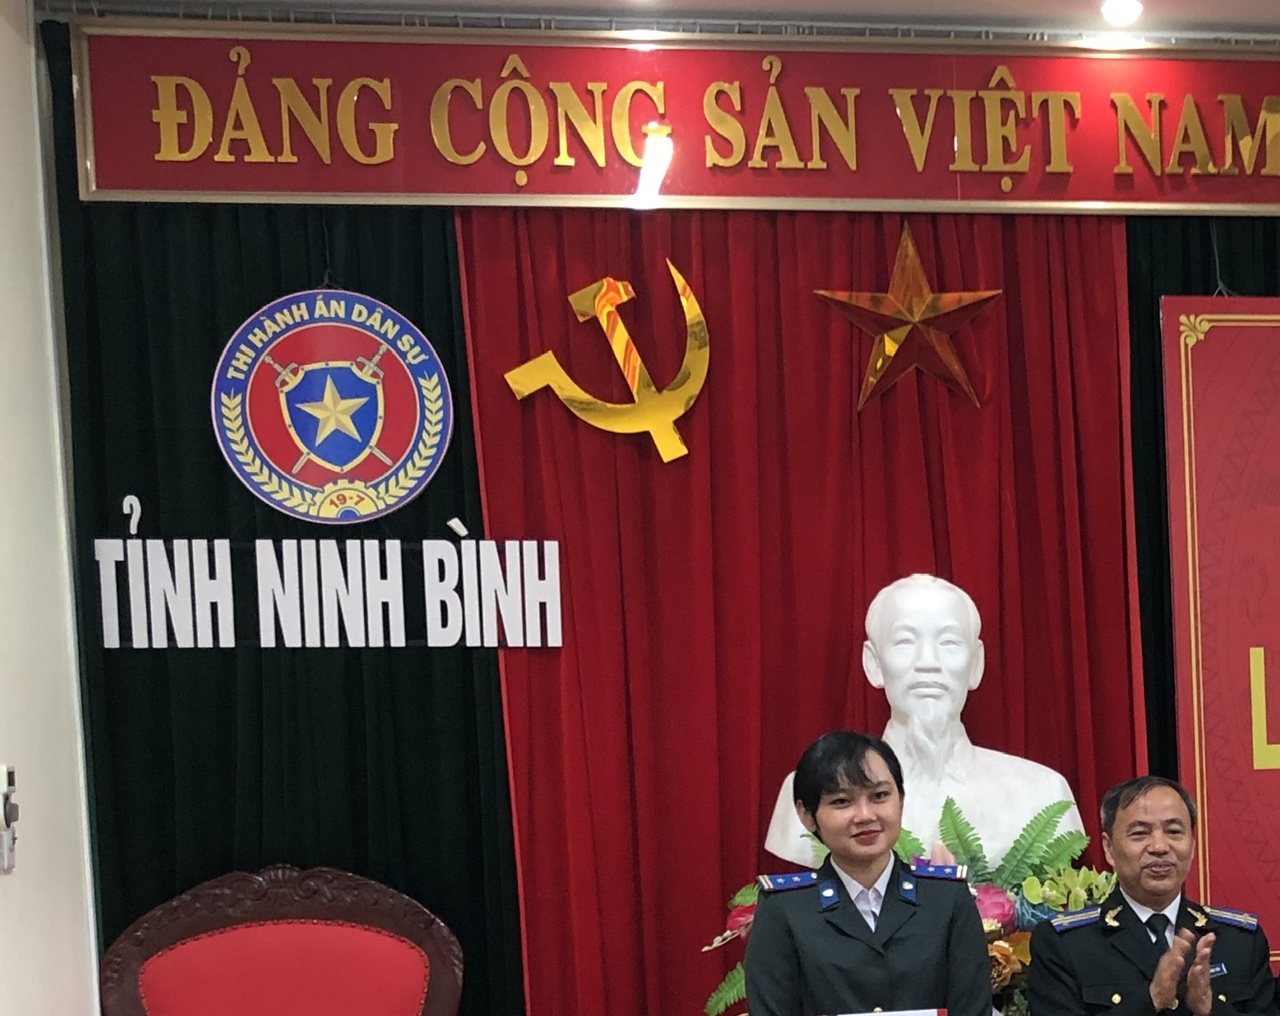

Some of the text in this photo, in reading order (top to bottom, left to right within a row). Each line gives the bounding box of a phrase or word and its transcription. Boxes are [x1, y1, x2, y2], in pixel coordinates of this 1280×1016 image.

[151, 48, 399, 166] ĐẢNG
[430, 54, 674, 187] CỘNG
[703, 55, 861, 171] SẢN
[889, 66, 1082, 193] VIỆT
[227, 295, 429, 381] THI HÀNH ÁN DÂN SỰ
[329, 493, 365, 509] 19-7
[94, 495, 563, 648] TỈNH NINH BÌNH
